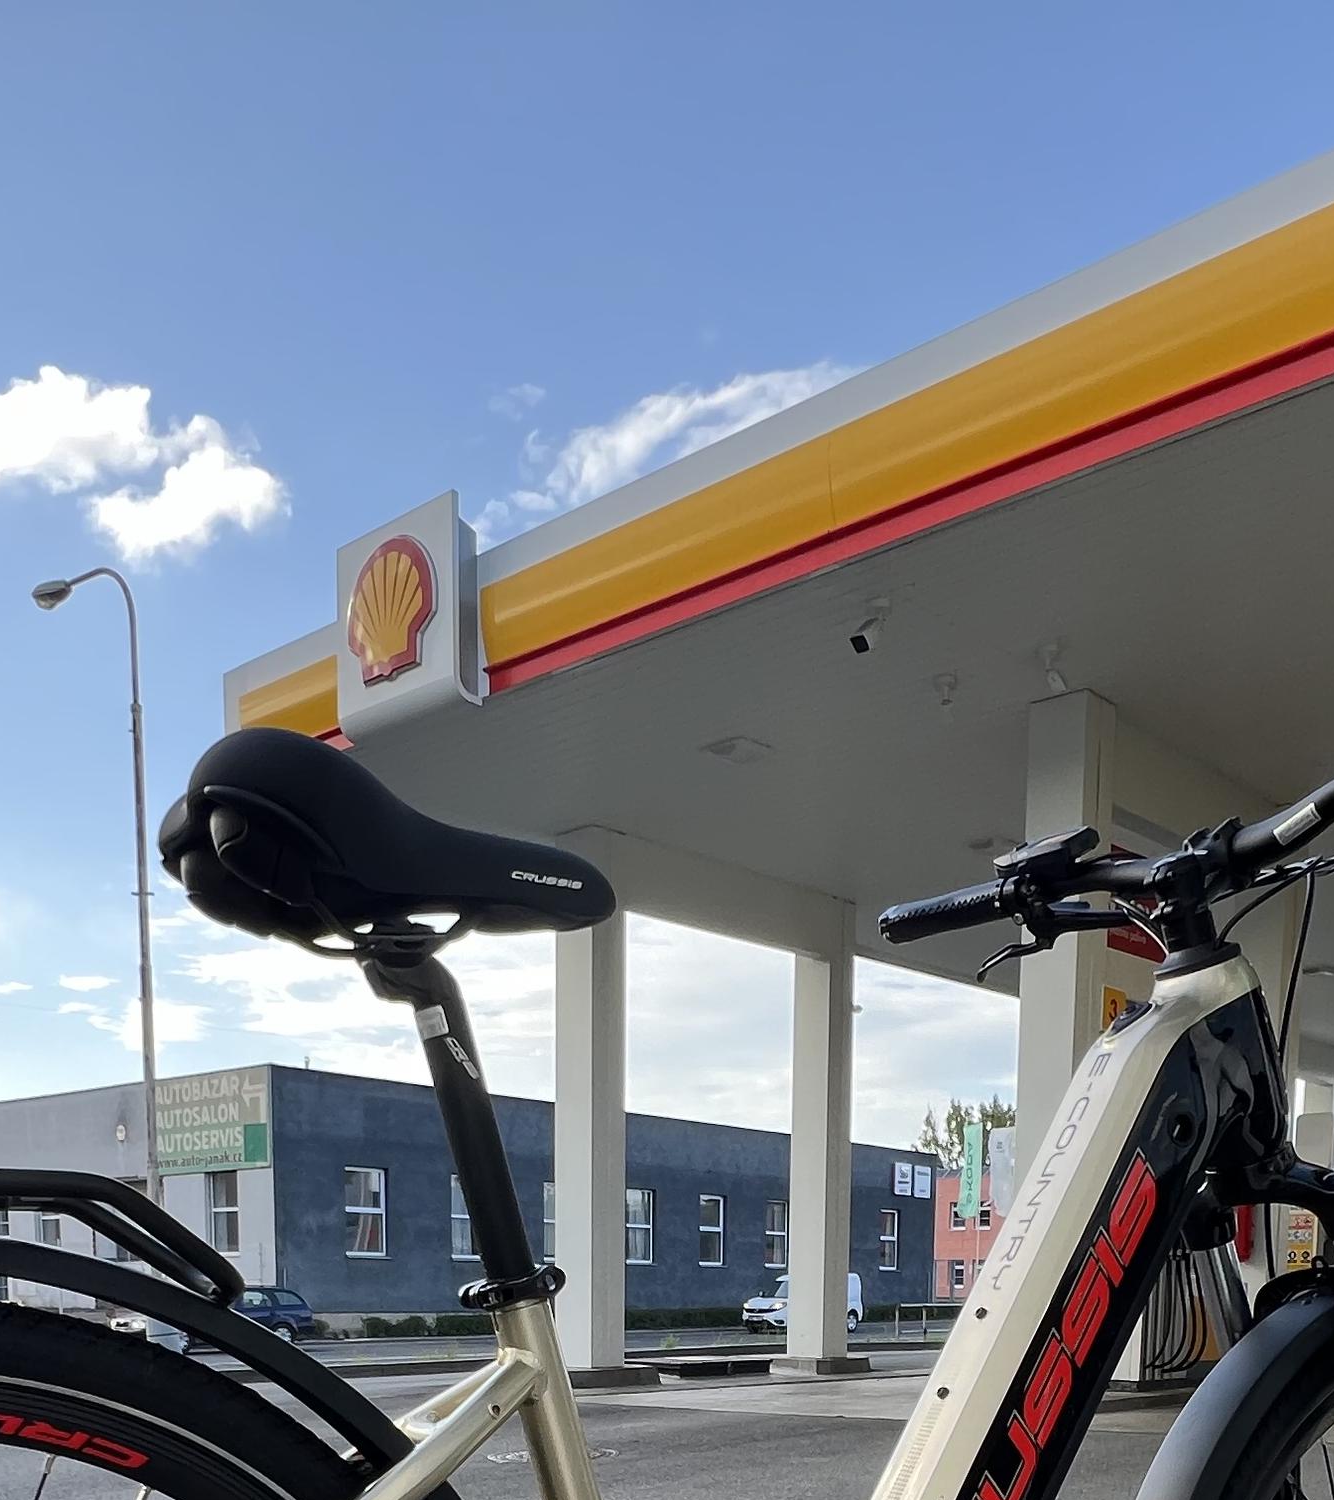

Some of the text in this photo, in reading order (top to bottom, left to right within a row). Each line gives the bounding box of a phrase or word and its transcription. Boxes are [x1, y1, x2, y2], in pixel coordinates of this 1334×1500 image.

[511, 870, 584, 890] CRUSSIS
[155, 1074, 240, 1105] AUTOBAZAR
[155, 1102, 240, 1130] AUTOSALON
[156, 1126, 244, 1154] AUTOSERVIS
[991, 1052, 1112, 1291] E-COUNTRY
